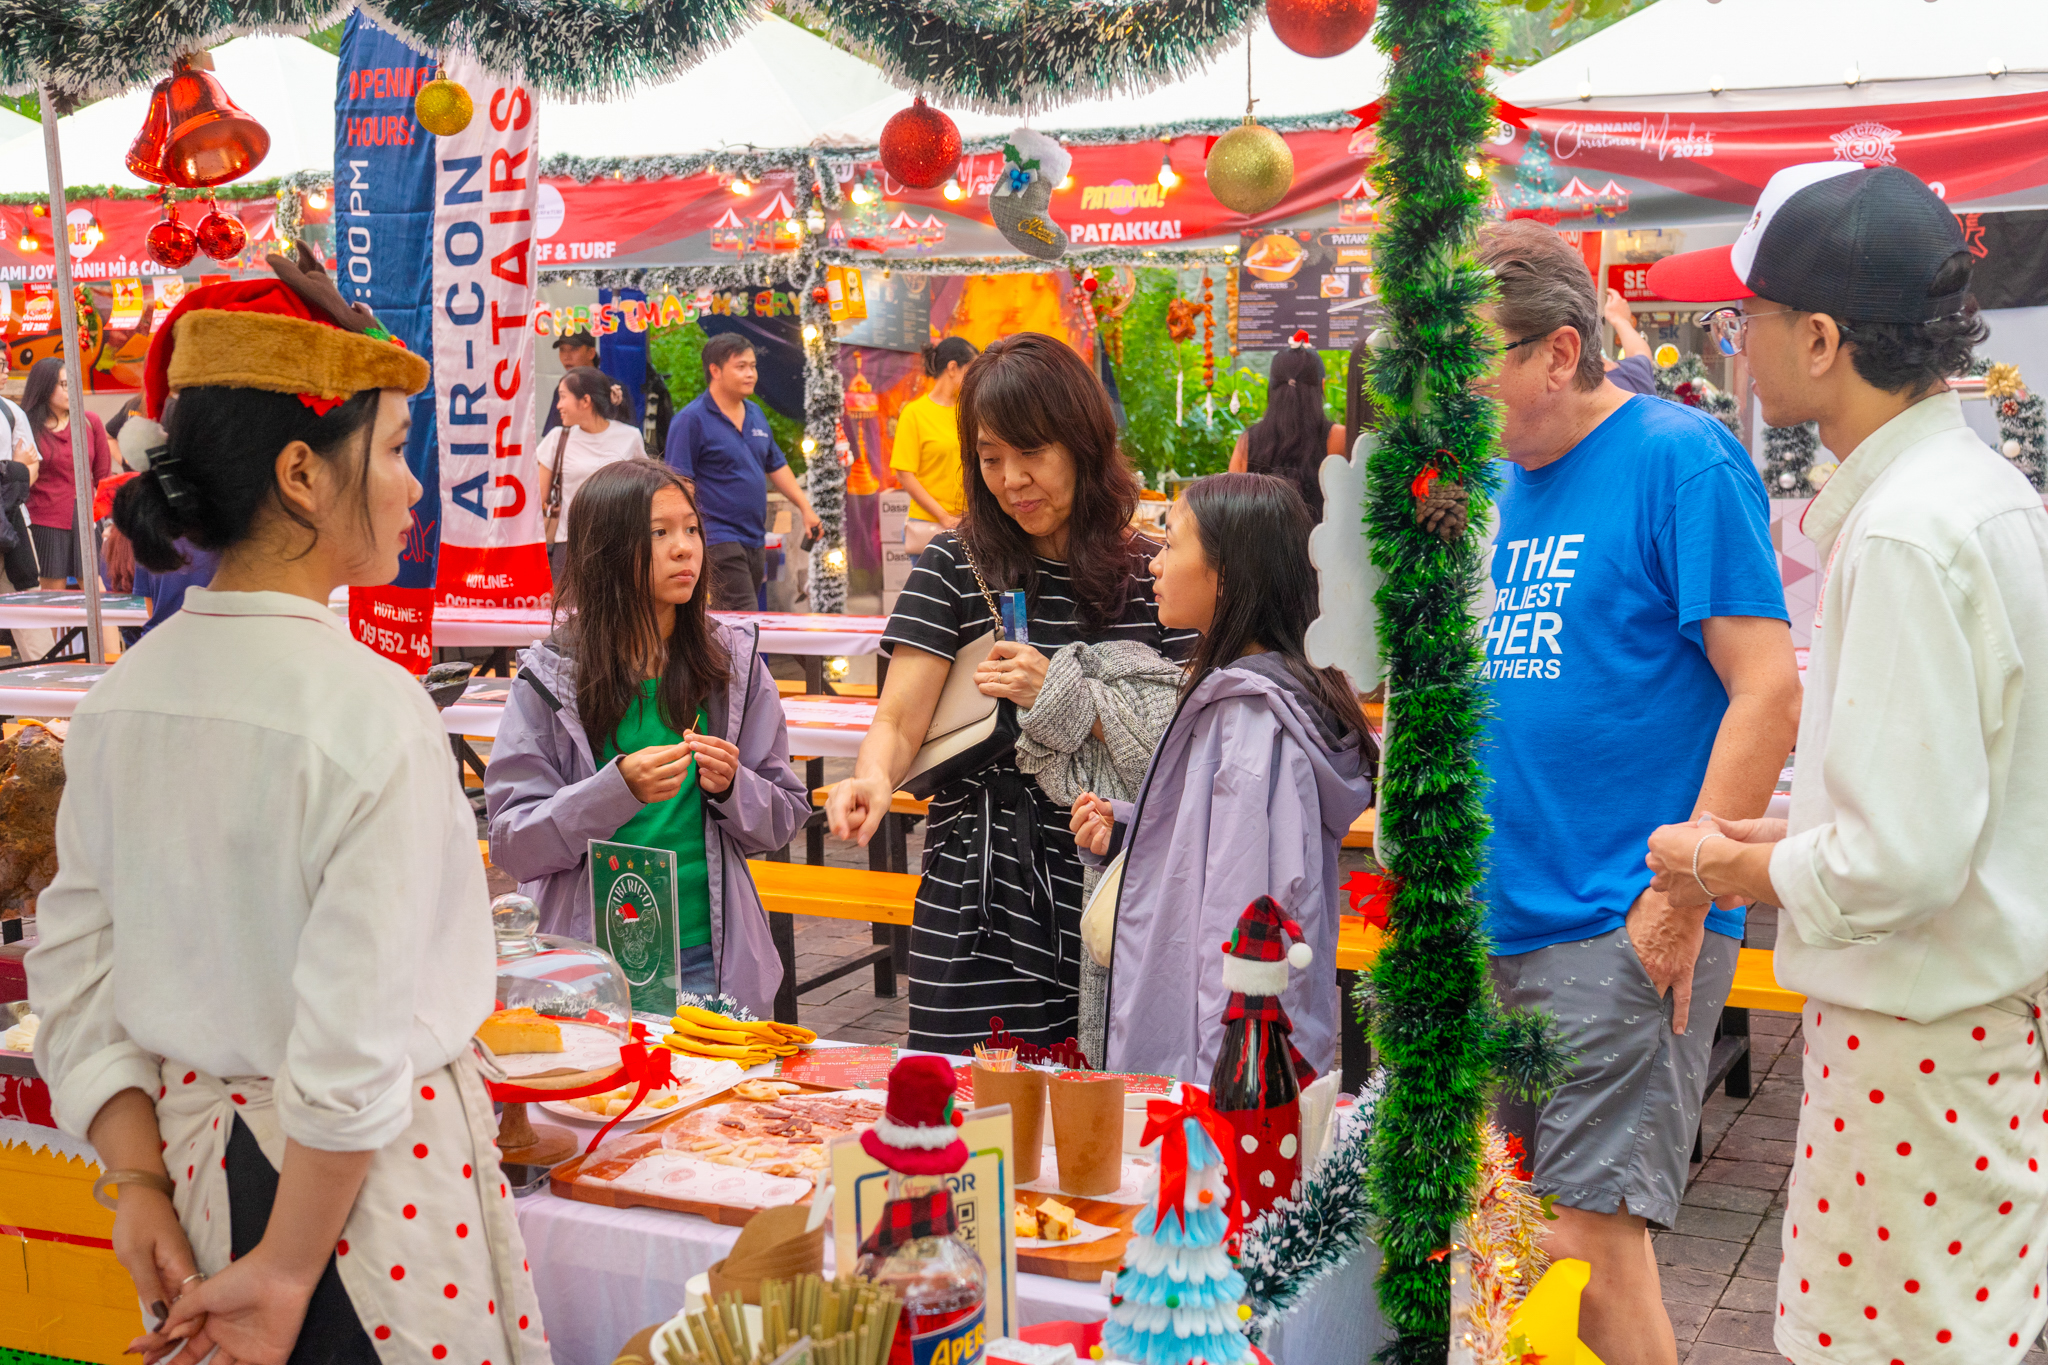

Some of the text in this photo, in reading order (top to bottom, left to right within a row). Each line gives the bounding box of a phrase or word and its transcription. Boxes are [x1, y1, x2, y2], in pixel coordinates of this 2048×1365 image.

[347, 115, 415, 147] HOURS:
[1554, 113, 1717, 161] Christmas Market
[1585, 122, 1641, 133] DANANG
[1673, 144, 1714, 158] 2025
[1852, 140, 1877, 156] 30
[1080, 183, 1170, 210] PATAKKA!
[348, 160, 371, 299] :00 PM
[1070, 220, 1182, 243] PATAKKA!
[536, 241, 616, 261] RF & TURF
[0, 265, 26, 281] AMI
[29, 264, 55, 281] JOY
[108, 254, 126, 276] MÌ
[129, 261, 139, 276] &
[534, 292, 700, 337] CHRISTMAS
[442, 155, 489, 520] AIR-CON
[1506, 534, 1585, 583] THE
[466, 574, 514, 589] HOTLINE:
[1494, 582, 1571, 612] RLIEST
[374, 600, 423, 623] HOTLINE:
[410, 633, 430, 658] 46
[1476, 659, 1561, 679] ATHERS
[930, 1322, 985, 1365] APER
